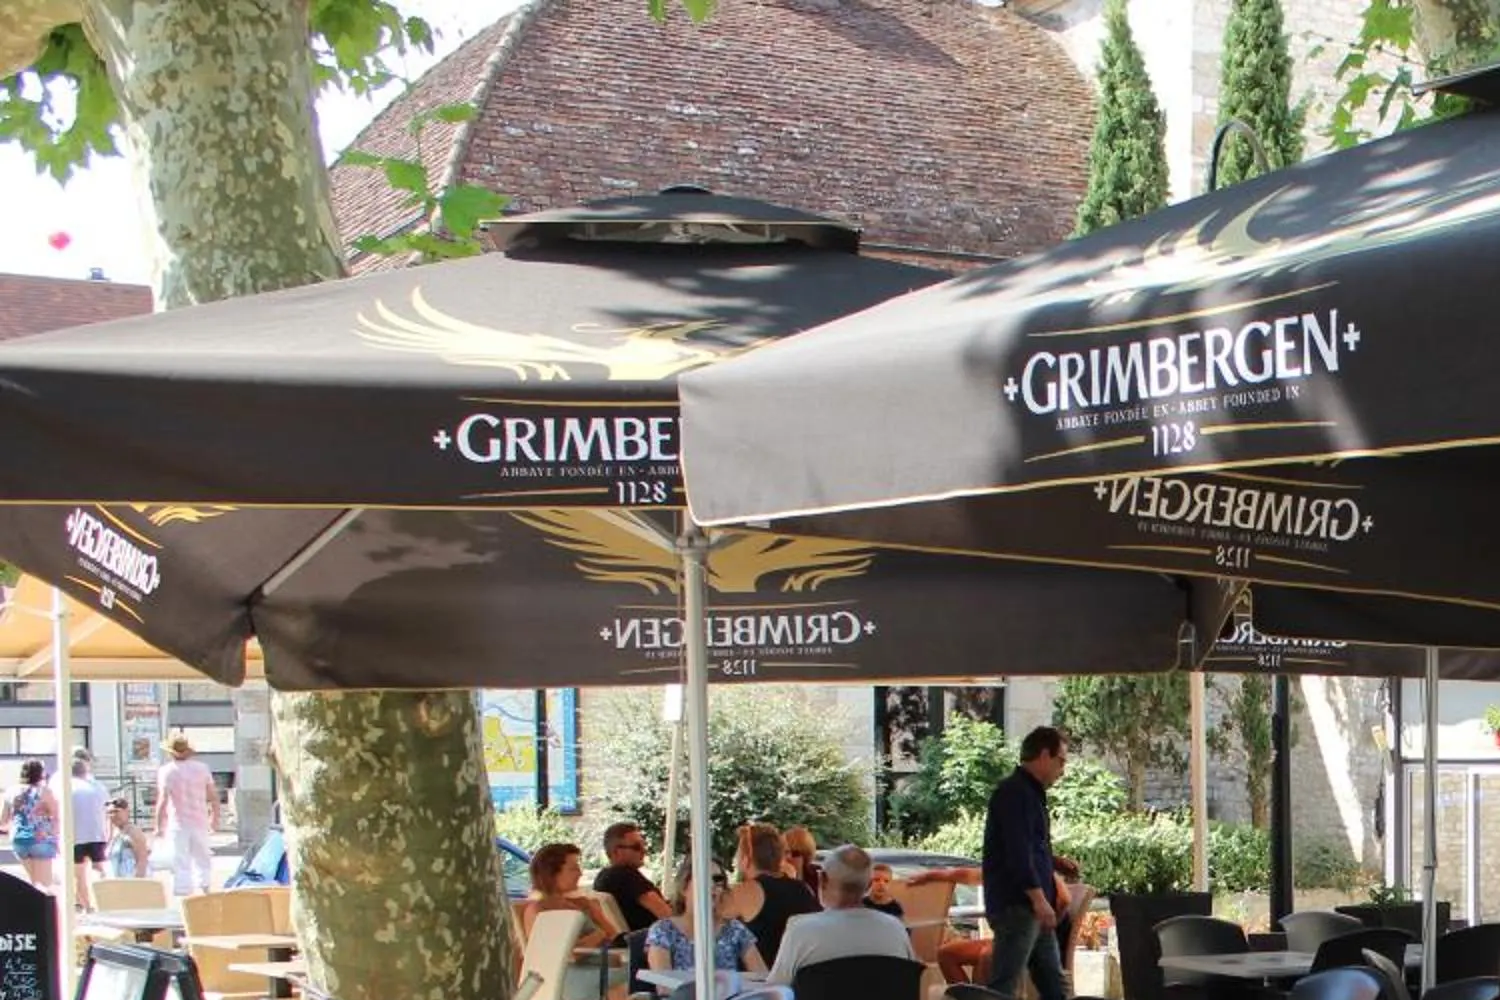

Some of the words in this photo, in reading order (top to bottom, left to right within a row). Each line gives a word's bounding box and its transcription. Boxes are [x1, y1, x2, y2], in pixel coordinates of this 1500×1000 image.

[1021, 308, 1338, 415] GRIMBERGEN
[1223, 386, 1281, 409] FOUNDED
[456, 413, 682, 463] GRIMBE
[1151, 420, 1196, 457] 1128
[616, 481, 667, 504] 1128
